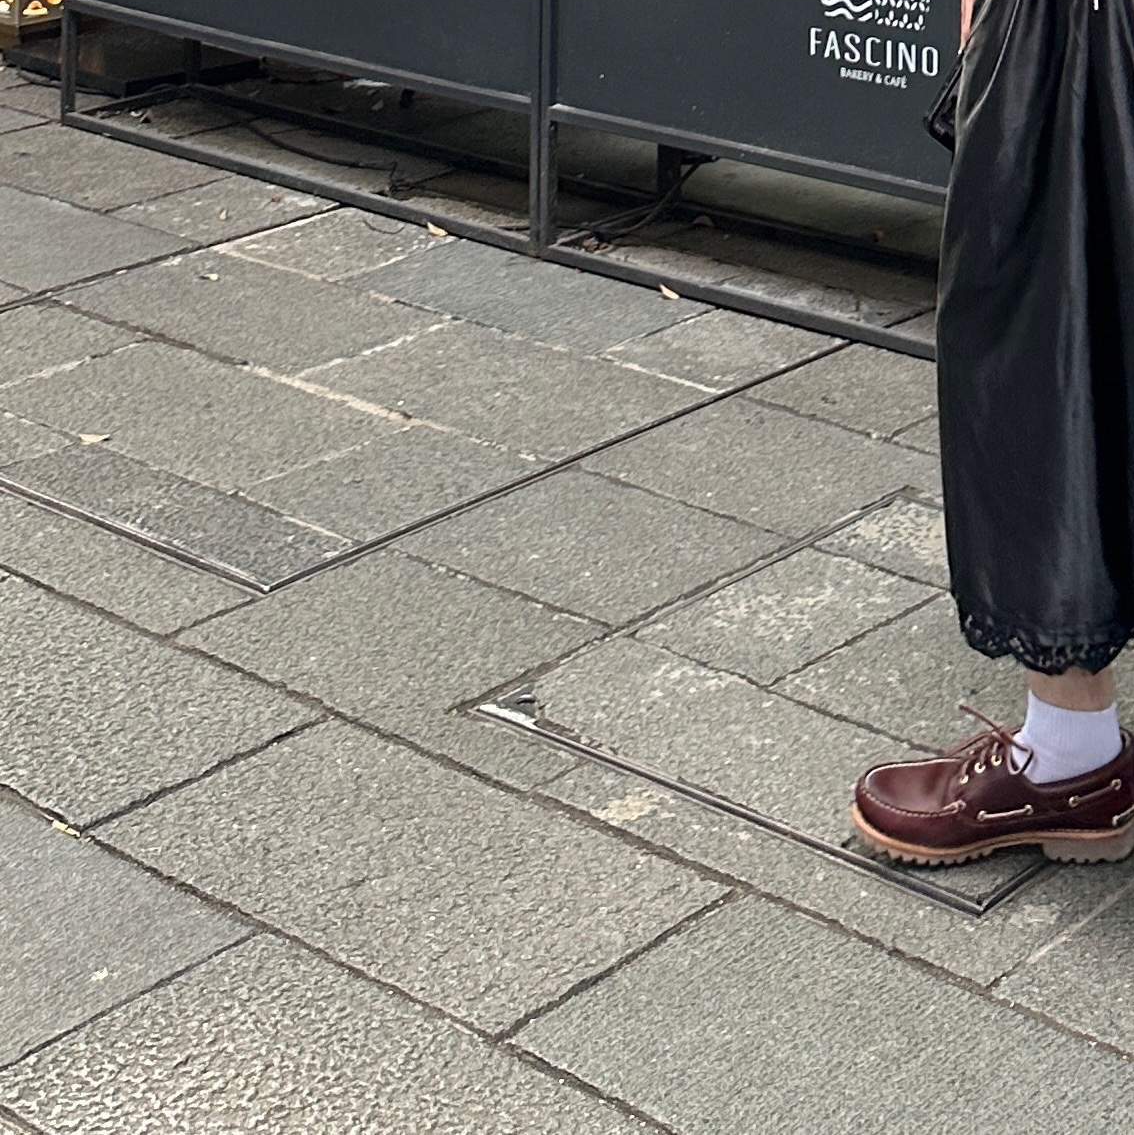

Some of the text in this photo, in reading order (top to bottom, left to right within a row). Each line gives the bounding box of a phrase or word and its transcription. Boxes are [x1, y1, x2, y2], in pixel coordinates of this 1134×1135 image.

[809, 27, 939, 77] FASCINO
[840, 66, 908, 89] BAKERY & CAFÉ
